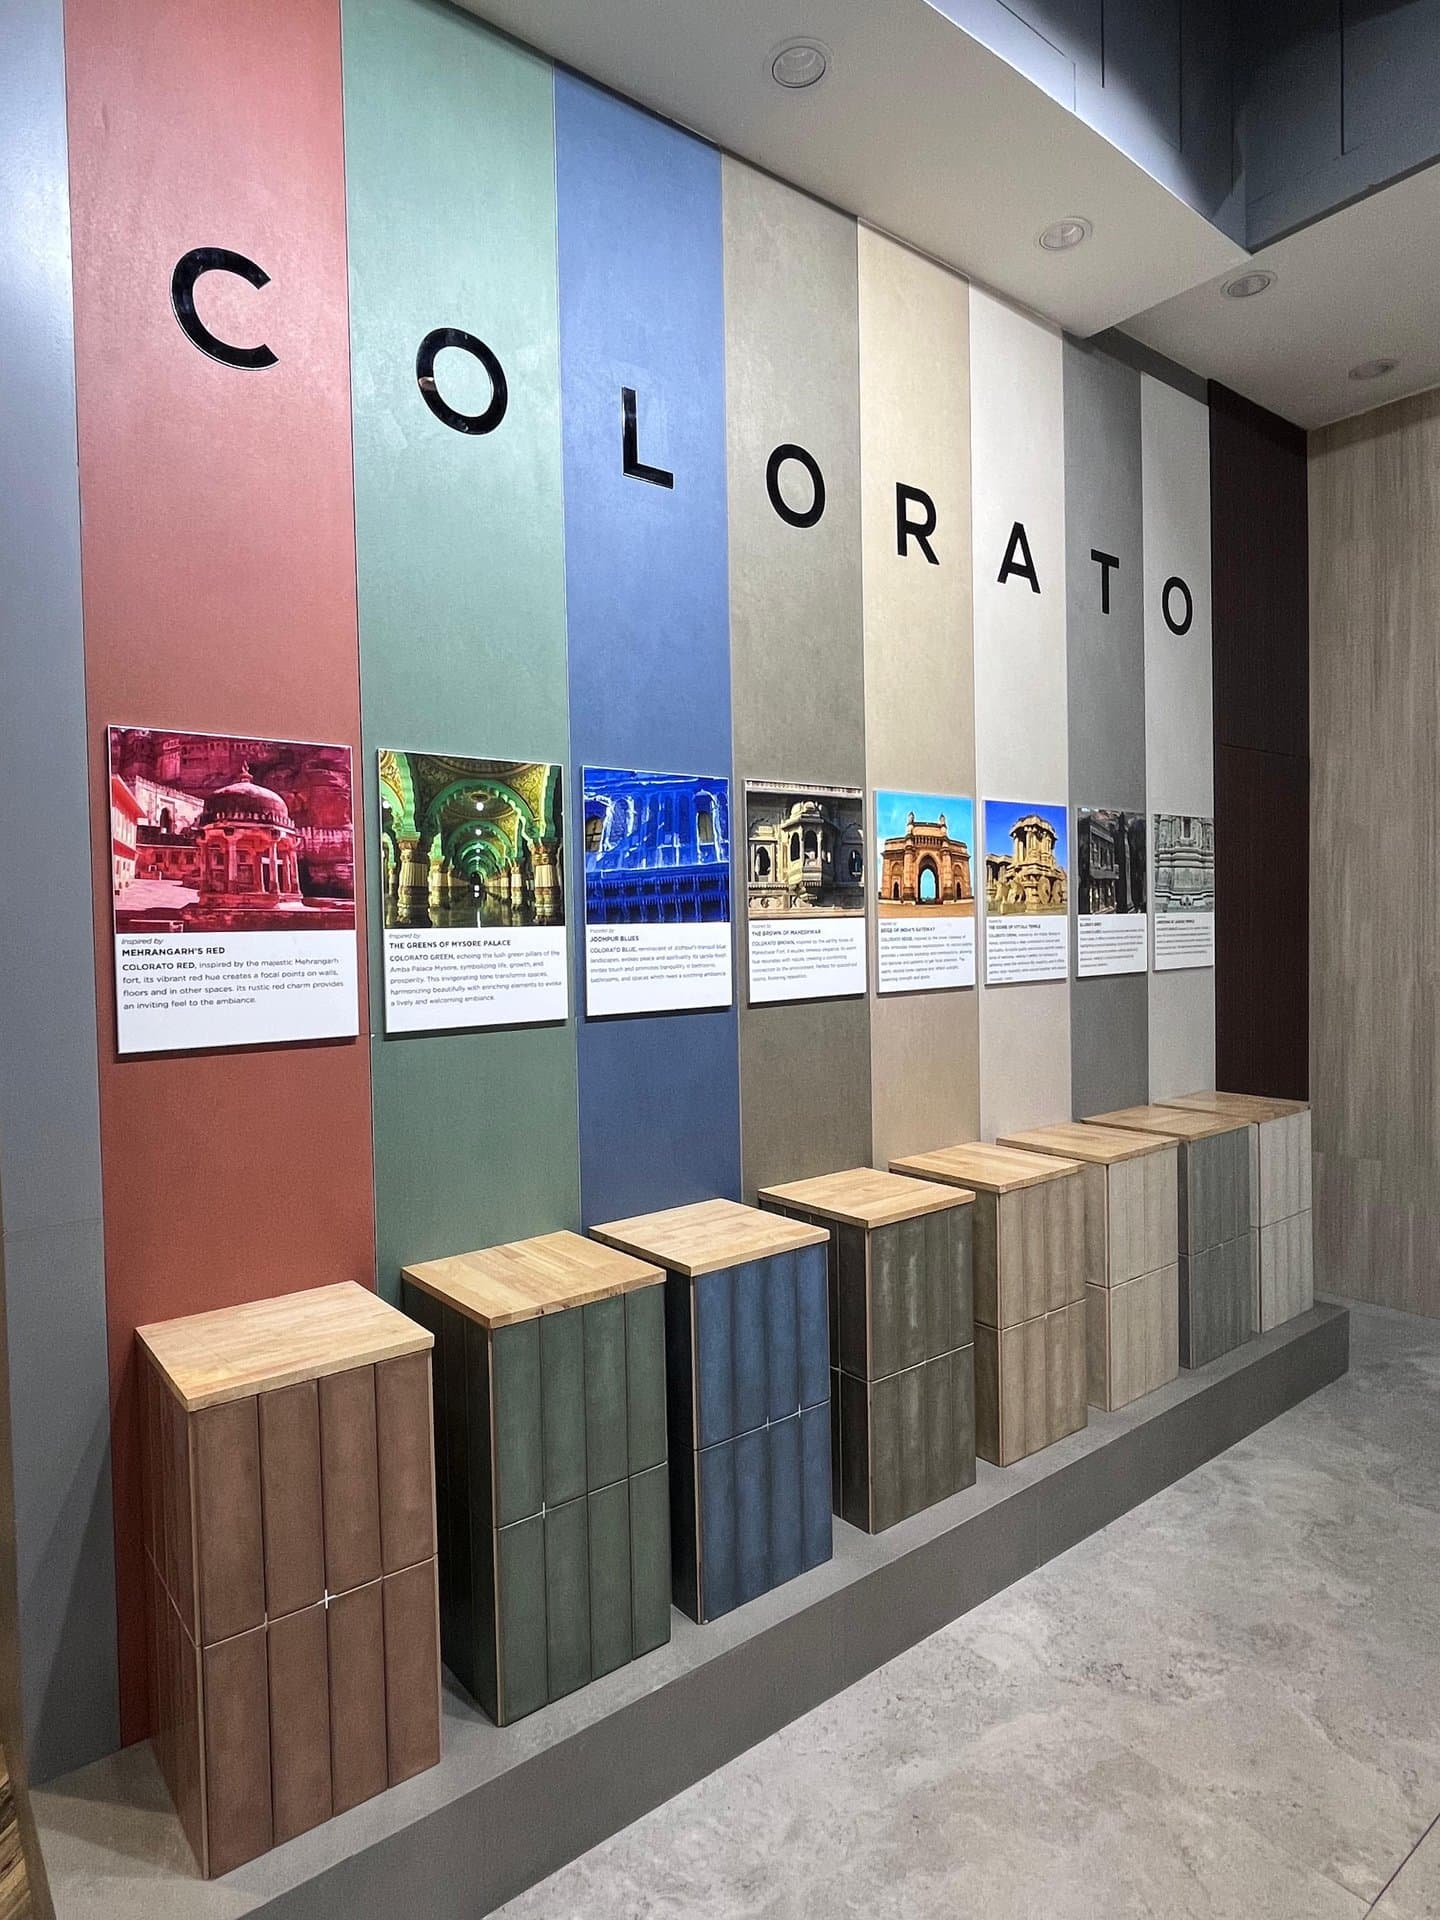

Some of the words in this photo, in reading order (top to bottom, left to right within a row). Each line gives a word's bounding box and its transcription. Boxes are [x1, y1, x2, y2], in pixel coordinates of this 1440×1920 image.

[122, 947, 203, 956] MEHRANGARH'S
[389, 954, 428, 962] COLORATO
[122, 963, 174, 971] COLORATO
[199, 961, 231, 969] inspired
[261, 959, 293, 967] majestic
[295, 958, 339, 966] Mehrangarh
[151, 988, 167, 996] and
[205, 986, 232, 994] spaces.
[313, 981, 343, 989] provides
[137, 1001, 169, 1009] inviting
